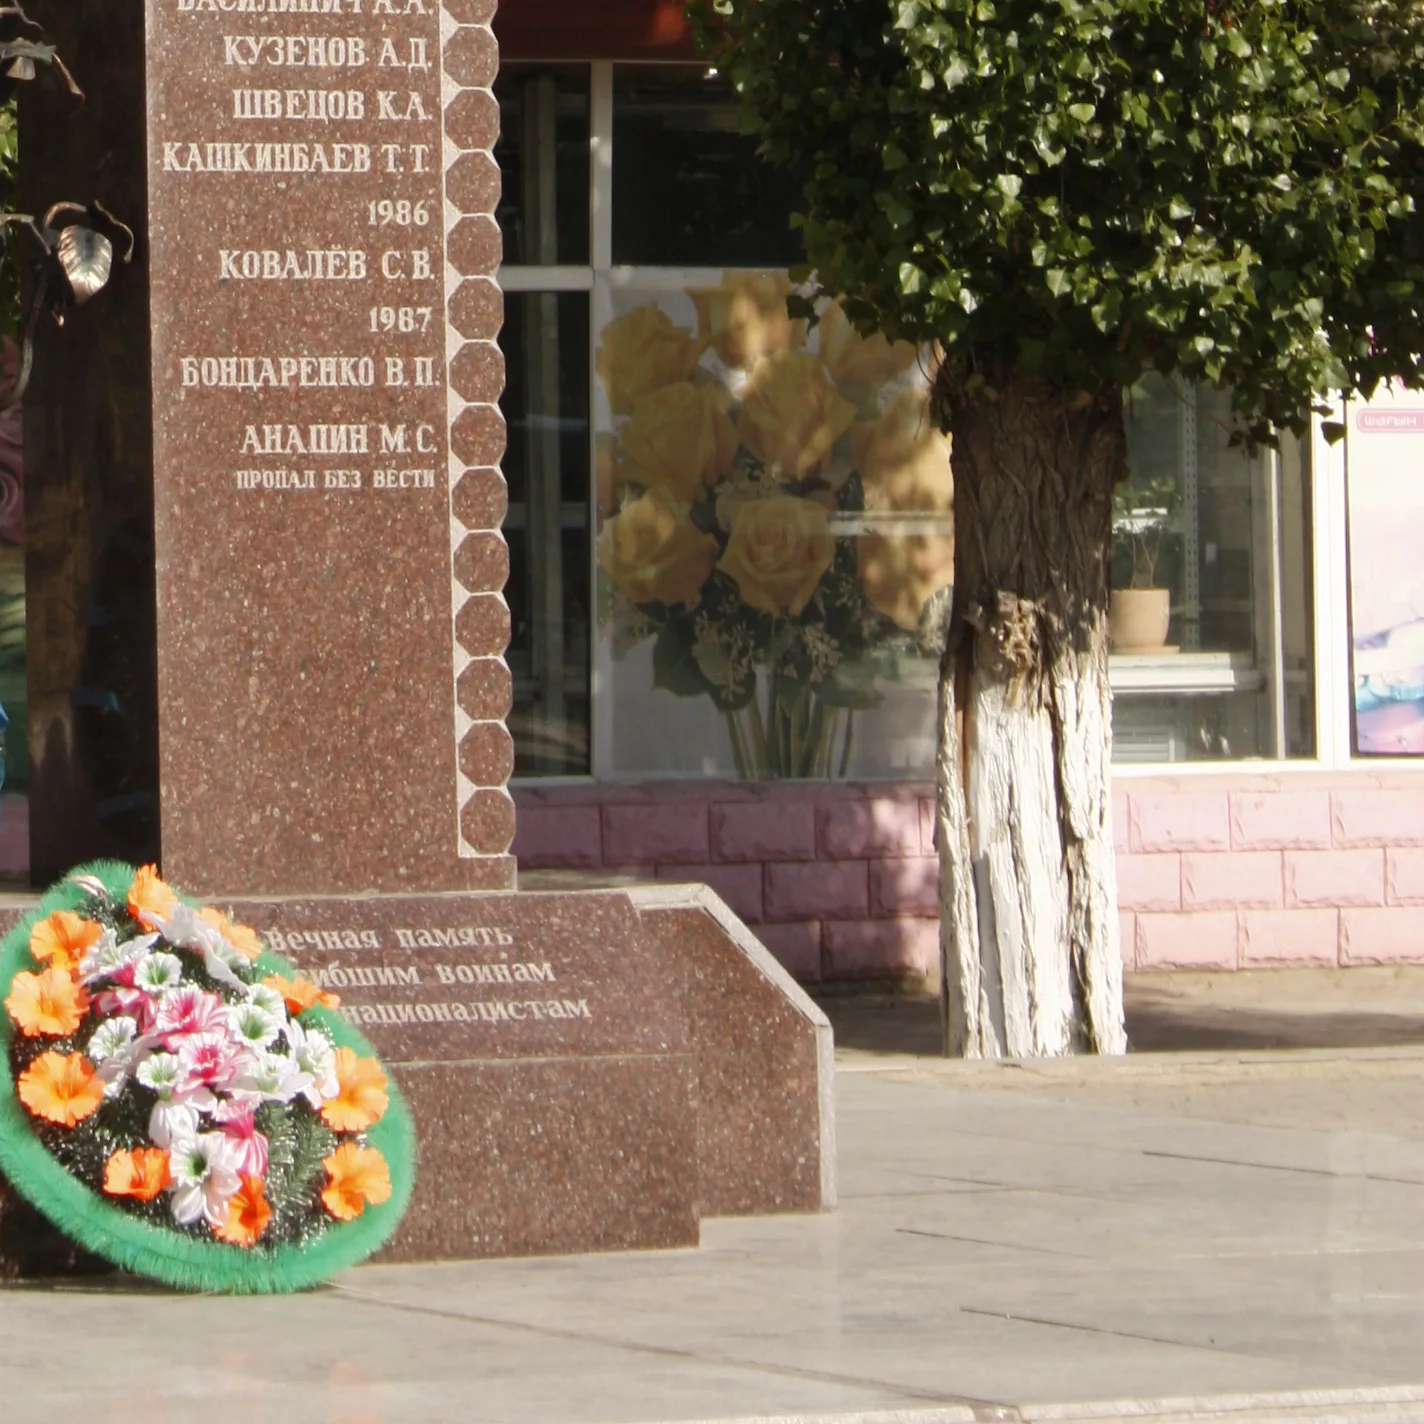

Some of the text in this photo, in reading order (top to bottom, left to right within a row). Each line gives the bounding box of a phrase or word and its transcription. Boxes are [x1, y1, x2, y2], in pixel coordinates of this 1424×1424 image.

[224, 36, 366, 67] КУЗЕНОВ
[232, 89, 365, 125] ШВЕЦОВ
[162, 142, 371, 173] КАШКИНБАЕВ
[367, 200, 429, 226] 1986
[369, 307, 433, 334] 1987
[180, 356, 375, 391] БОНДАРЕНКО
[240, 424, 369, 453] АНАПИН
[236, 470, 435, 489] ПРОПАЛ БЕЗ ВЕСТИ
[394, 926, 514, 949] память
[434, 962, 556, 986] воинам
